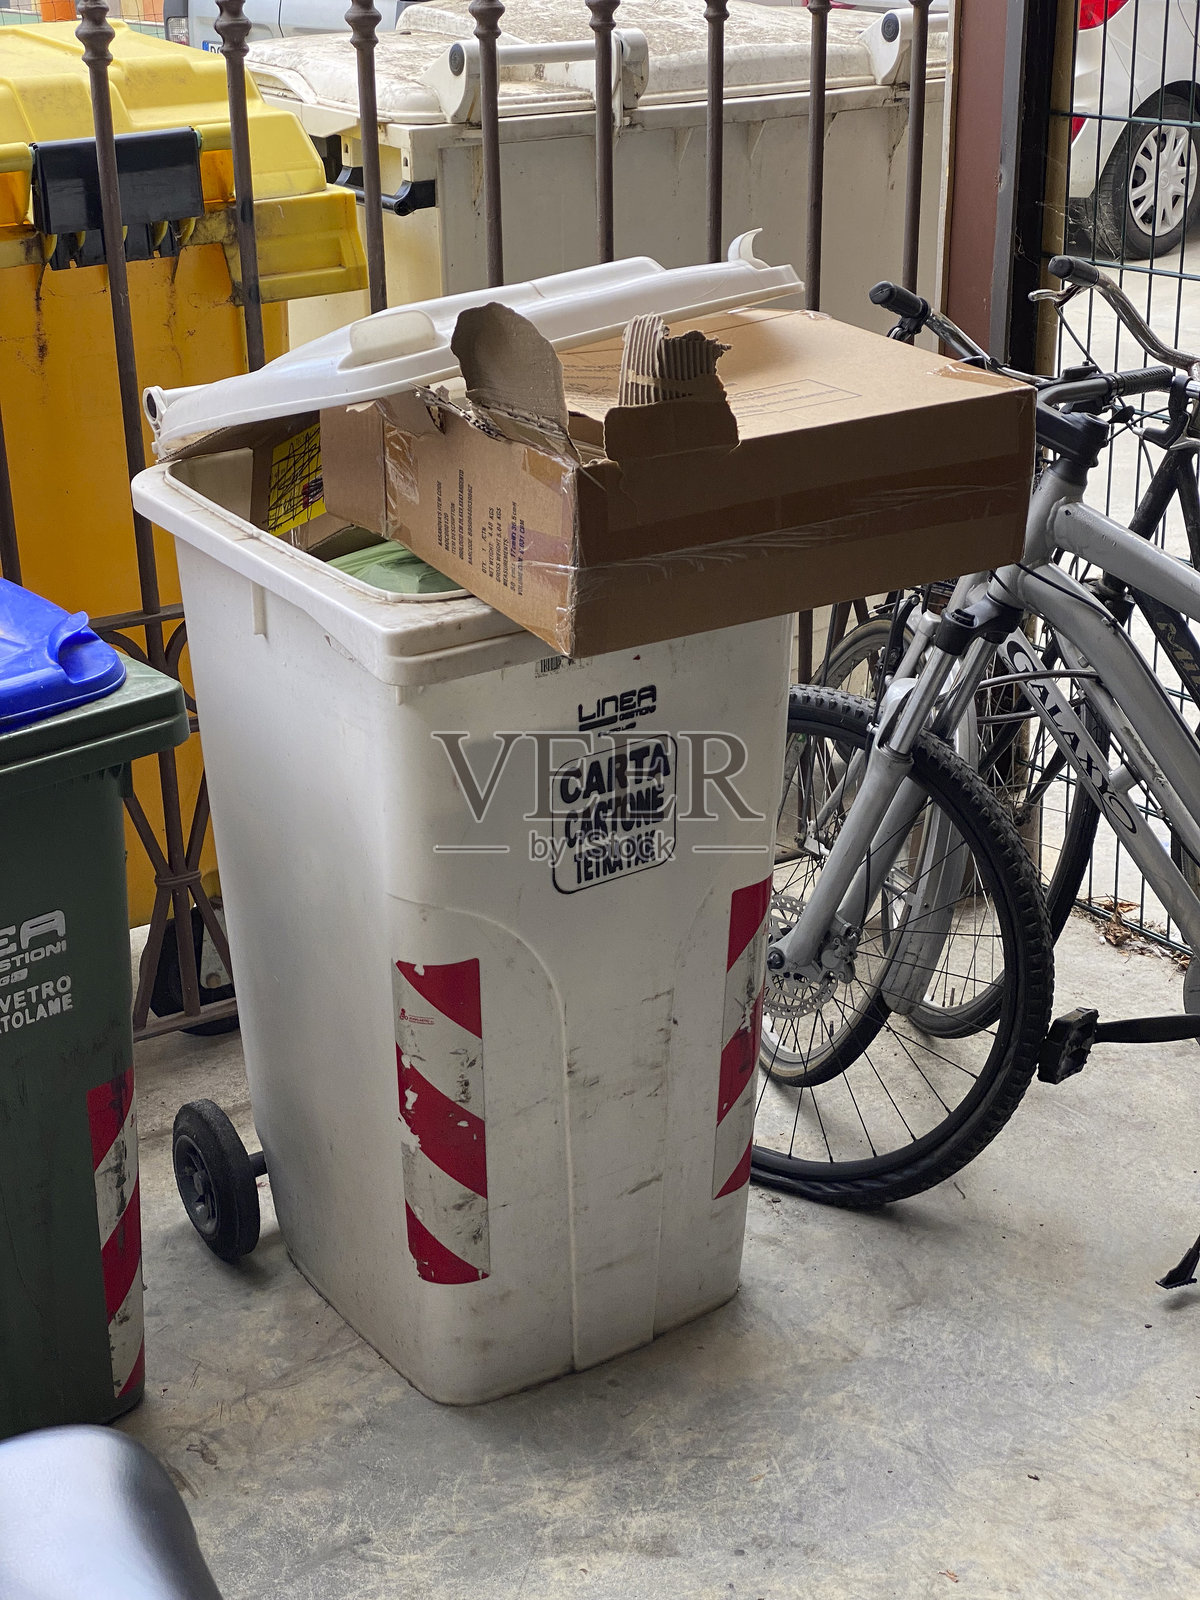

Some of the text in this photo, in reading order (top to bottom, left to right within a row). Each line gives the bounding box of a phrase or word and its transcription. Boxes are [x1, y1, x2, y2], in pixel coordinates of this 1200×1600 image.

[578, 684, 657, 722] LINEA
[1002, 640, 1137, 835] GALAXY
[560, 743, 671, 804] CARTA
[0, 993, 73, 1034] TOLAME
